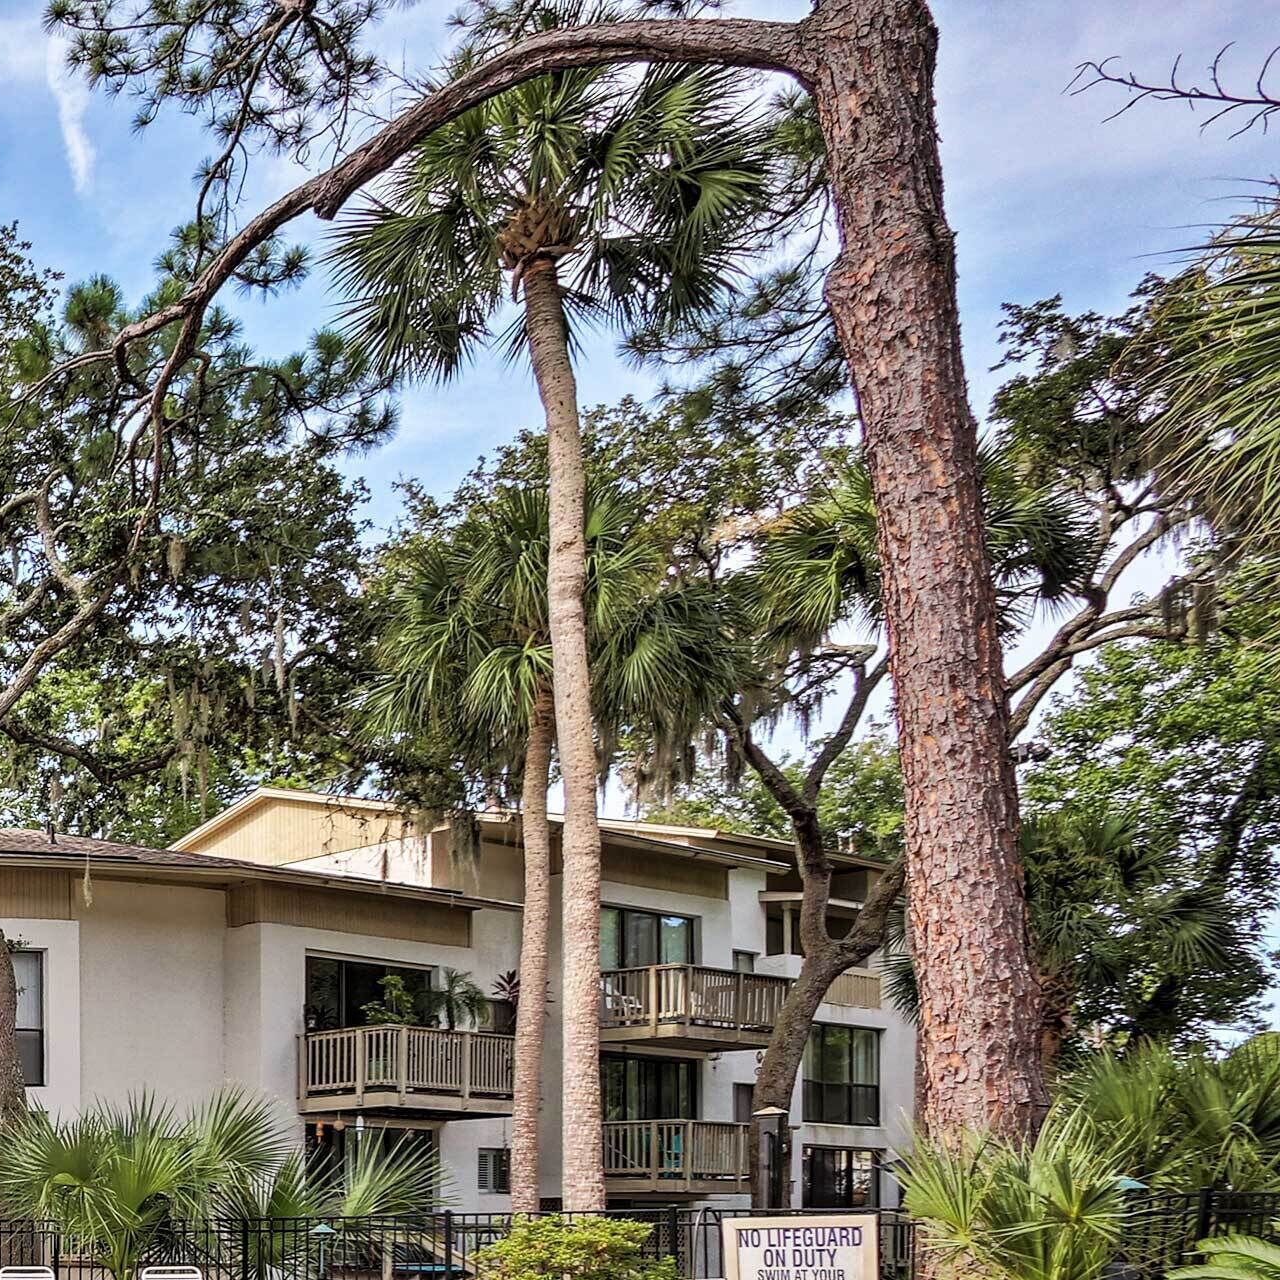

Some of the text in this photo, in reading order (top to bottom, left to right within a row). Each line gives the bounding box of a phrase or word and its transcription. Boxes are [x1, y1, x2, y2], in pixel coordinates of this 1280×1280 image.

[739, 1227, 863, 1248] NO LIFEGUARD
[764, 1249, 837, 1267] ON DUTY
[813, 1269, 846, 1280] YOUR
